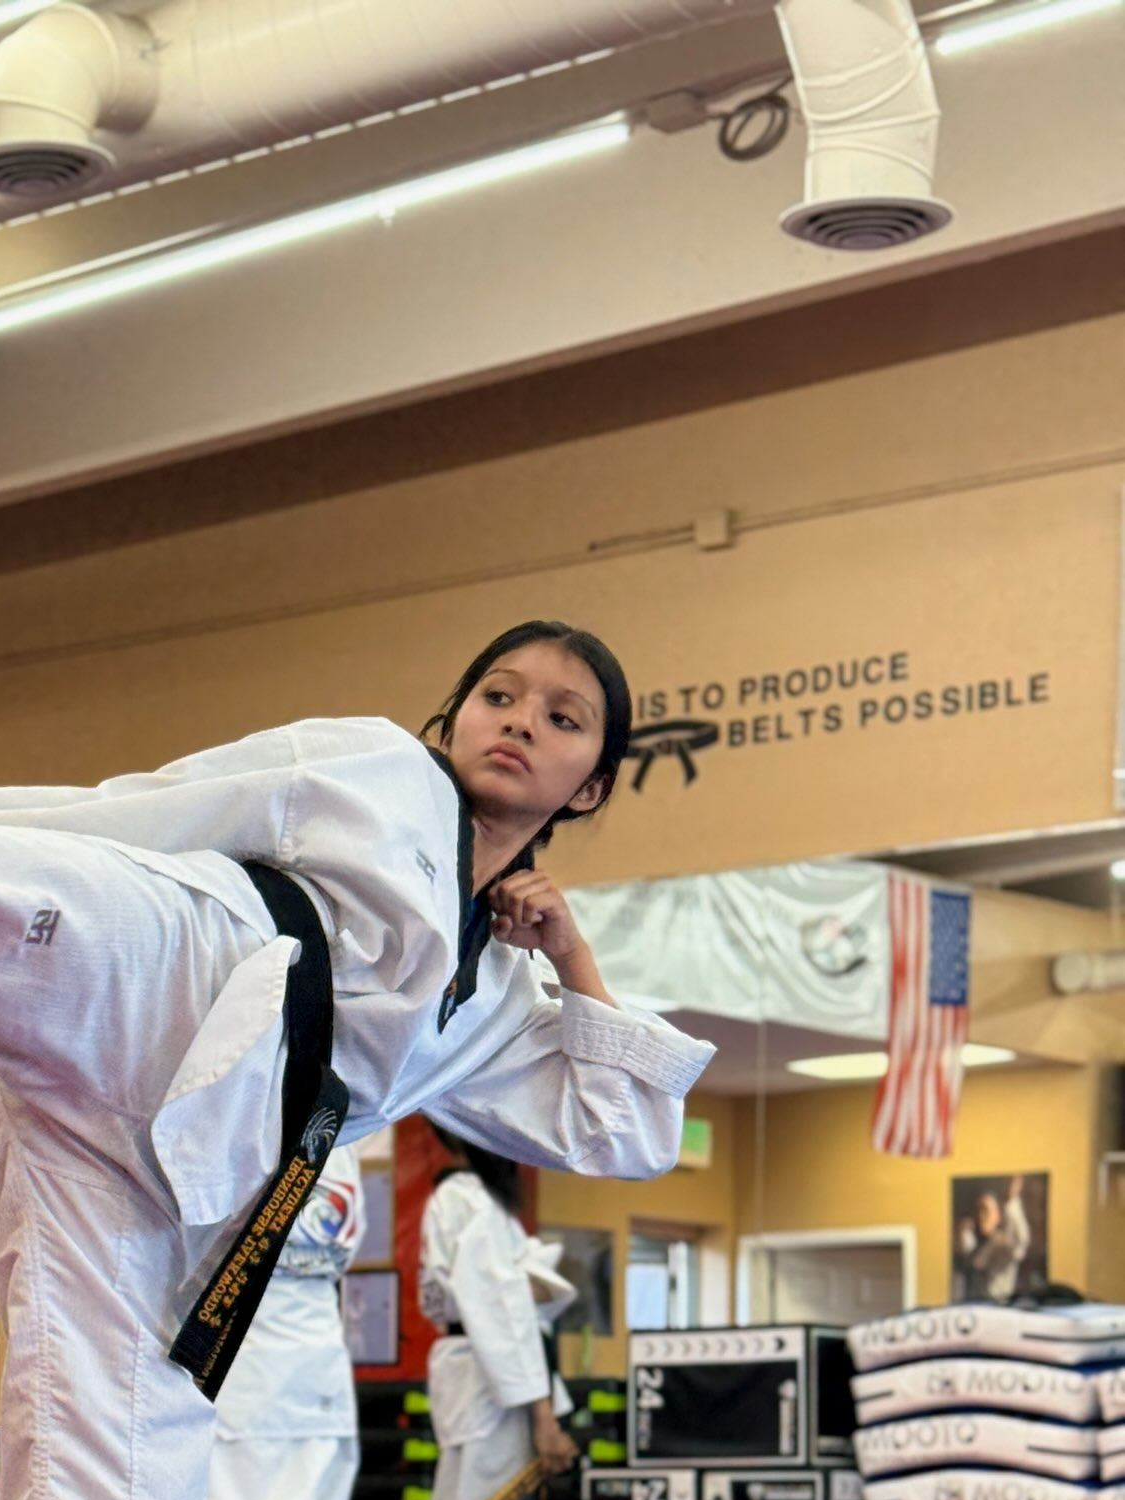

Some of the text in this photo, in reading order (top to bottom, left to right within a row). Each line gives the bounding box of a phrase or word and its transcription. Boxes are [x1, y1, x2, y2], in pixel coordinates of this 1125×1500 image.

[638, 652, 910, 719] IS TO PRODUCE
[727, 673, 1050, 748] BELTS POSSIBLE
[637, 1367, 665, 1410] 24
